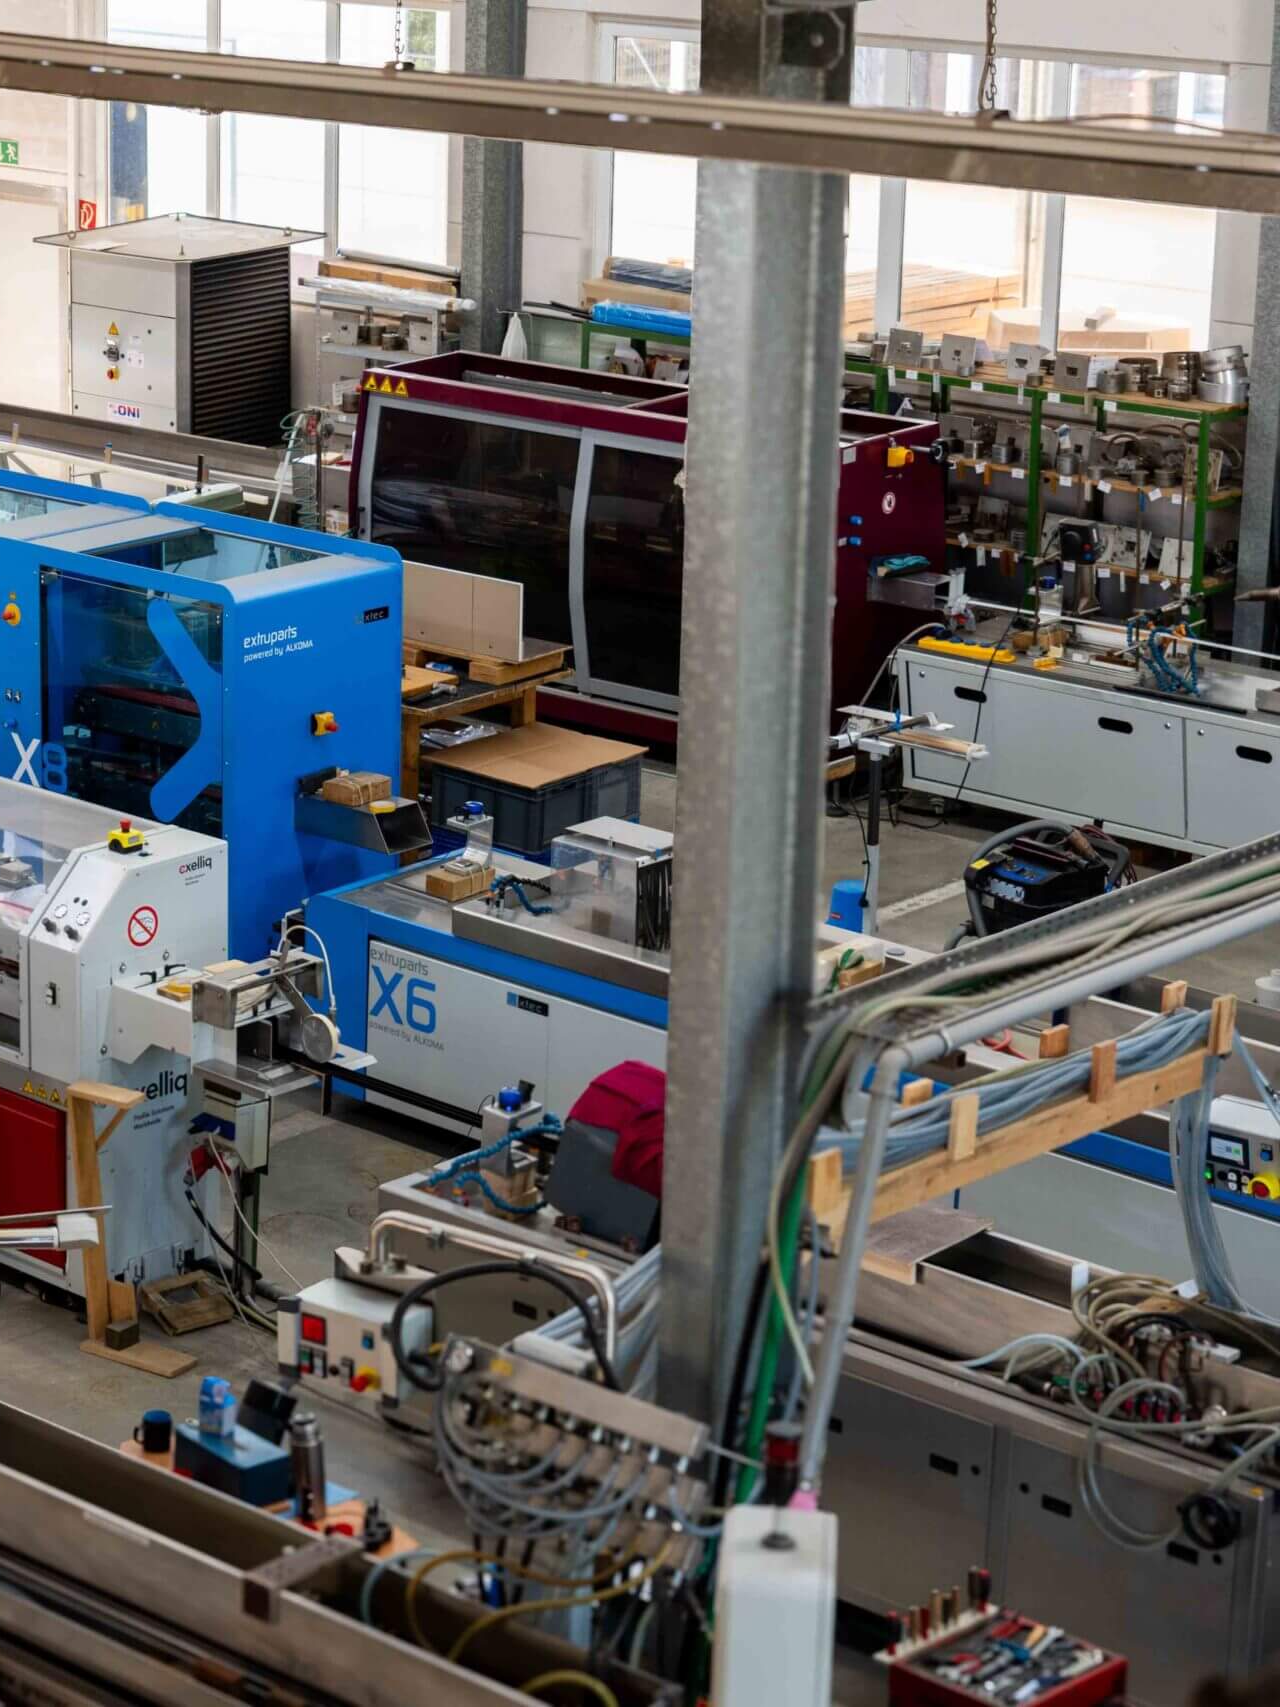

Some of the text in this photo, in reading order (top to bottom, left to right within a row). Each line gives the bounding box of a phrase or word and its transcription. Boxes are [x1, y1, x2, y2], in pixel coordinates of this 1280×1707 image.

[118, 404, 140, 418] ONI
[243, 625, 297, 649] extruparts
[243, 639, 313, 663] powered by ALKOMA
[10, 731, 68, 794] X8
[370, 948, 429, 976] extruparts
[369, 964, 437, 1035] X6
